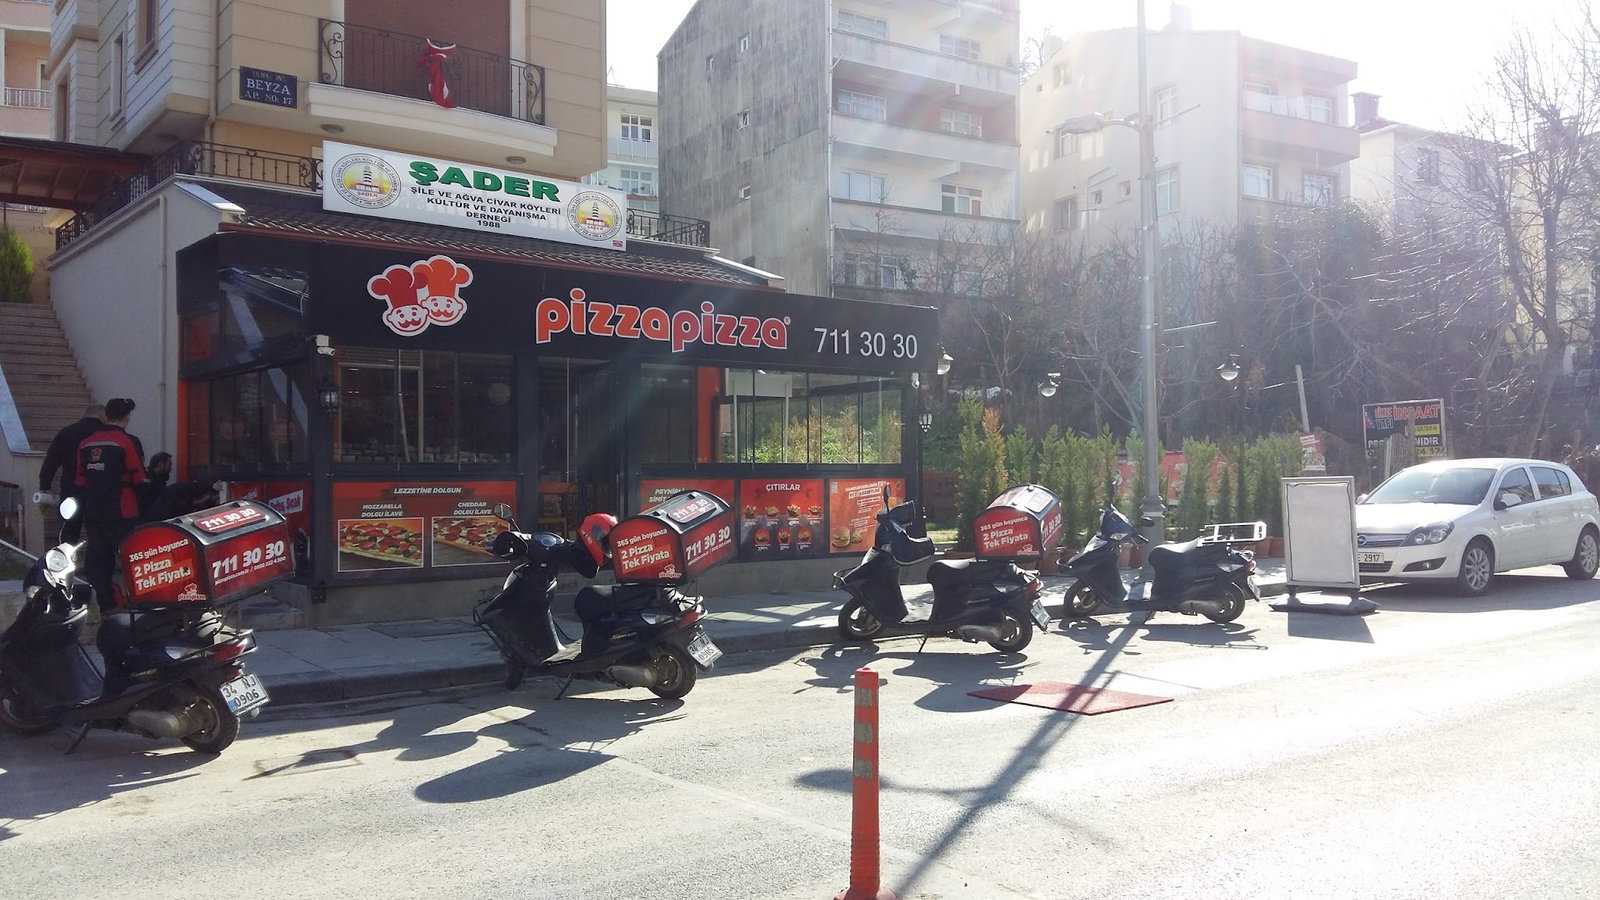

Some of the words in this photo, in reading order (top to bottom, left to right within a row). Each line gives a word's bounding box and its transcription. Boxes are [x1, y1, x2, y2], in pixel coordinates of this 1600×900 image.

[246, 78, 290, 95] BEYZA
[282, 96, 293, 105] 17
[408, 161, 561, 203] ŞADER
[410, 186, 435, 196] ŞİLE
[437, 190, 452, 199] VE
[455, 193, 484, 203] AĞVA
[520, 203, 561, 215] KÖYLERİ
[427, 197, 470, 210] KÜLTÜR
[473, 204, 487, 212] VE
[490, 206, 547, 221] DAYANIŞMA
[466, 211, 511, 223] DERNEĞİ
[477, 219, 501, 229] 1988
[814, 327, 850, 355] 711
[860, 331, 886, 357] 30
[893, 334, 919, 359] 30
[765, 483, 800, 492] ÇITIRLAR
[201, 517, 226, 529] 711
[223, 512, 241, 522] 30
[239, 508, 256, 518] 30
[672, 508, 689, 519] 711
[686, 503, 698, 511] 30
[695, 498, 709, 506] 30
[616, 540, 629, 548] 365
[629, 535, 642, 545] gün
[642, 528, 668, 541] boyunca
[685, 539, 702, 561] 711
[704, 533, 716, 550] 30
[718, 525, 731, 543] 30
[983, 533, 990, 541] 2
[990, 528, 1013, 539] Pizza
[984, 540, 1000, 549] Tek
[1001, 533, 1029, 545] Fiyata
[129, 551, 144, 562] 365
[144, 547, 158, 559] gün
[158, 538, 189, 553] boyunca
[212, 554, 238, 579] 711
[242, 547, 262, 568] 30
[265, 540, 285, 560] 30
[621, 550, 628, 560] 2
[629, 543, 654, 557] Pizza
[622, 558, 640, 570] Tek
[641, 550, 671, 565] Fiyata
[1364, 553, 1380, 563] 2917
[134, 565, 142, 578] 2
[143, 558, 172, 575] Pizza
[135, 575, 157, 591] Tek
[222, 685, 238, 698] 34
[242, 676, 257, 689] NJ
[233, 688, 260, 707] 0906
